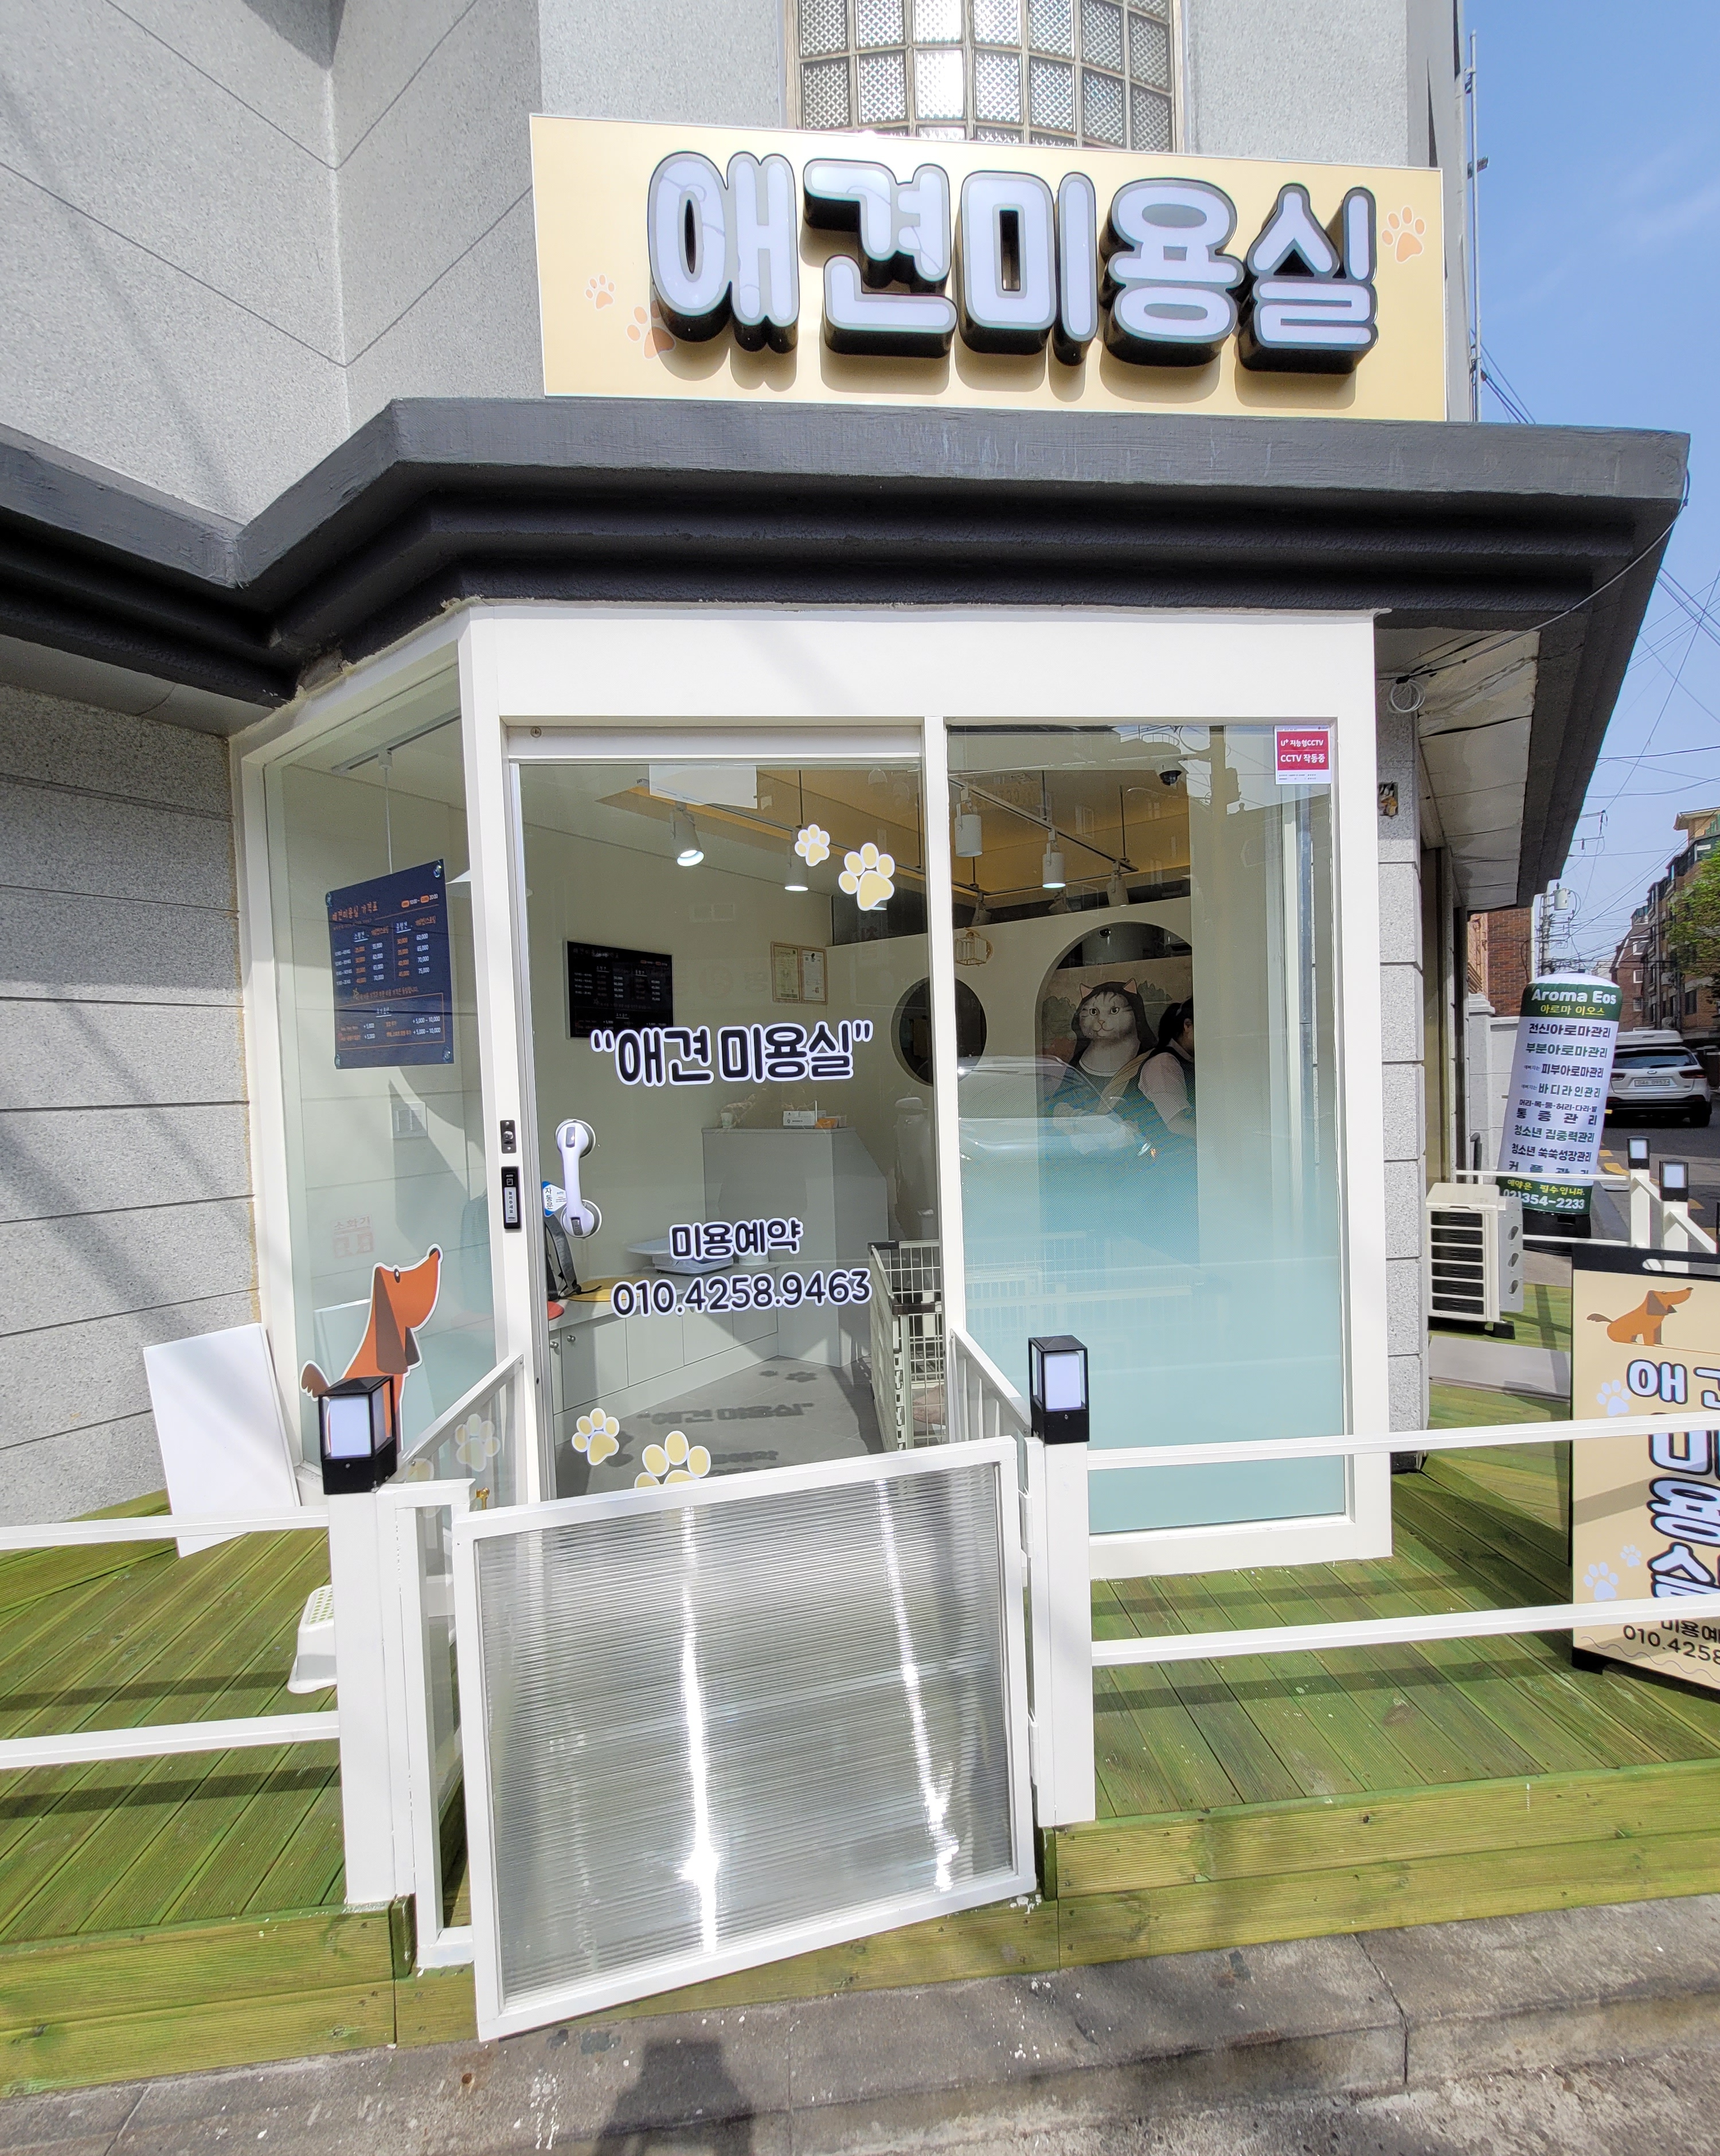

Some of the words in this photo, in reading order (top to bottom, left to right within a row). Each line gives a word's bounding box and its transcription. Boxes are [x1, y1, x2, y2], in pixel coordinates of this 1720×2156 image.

[647, 151, 1379, 368] 애견미용실
[1290, 739, 1324, 748] 지능형CCTV
[1280, 754, 1302, 763] CCTV
[1303, 753, 1326, 763] 작동중
[1531, 989, 1588, 1002] Aroma
[1592, 990, 1617, 1005] Eos
[1541, 1004, 1572, 1015] 아로마
[1575, 1005, 1605, 1016] 이오스
[1529, 1023, 1611, 1038] 전신아로마관리
[1526, 1042, 1609, 1059] 부분아로마관리
[1541, 1063, 1604, 1079] 피부아로마관리
[1514, 1124, 1542, 1138] 청소년
[1545, 1129, 1595, 1143] 집중력관리
[1512, 1143, 1535, 1157] 청소년
[1538, 1147, 1592, 1163] 쑥쑥성장관리
[1507, 1179, 1533, 1190] 예약은
[545, 1187, 553, 1210] 자동문
[669, 1217, 803, 1260] 미용예약
[611, 1267, 873, 1318] 010.4258.9463
